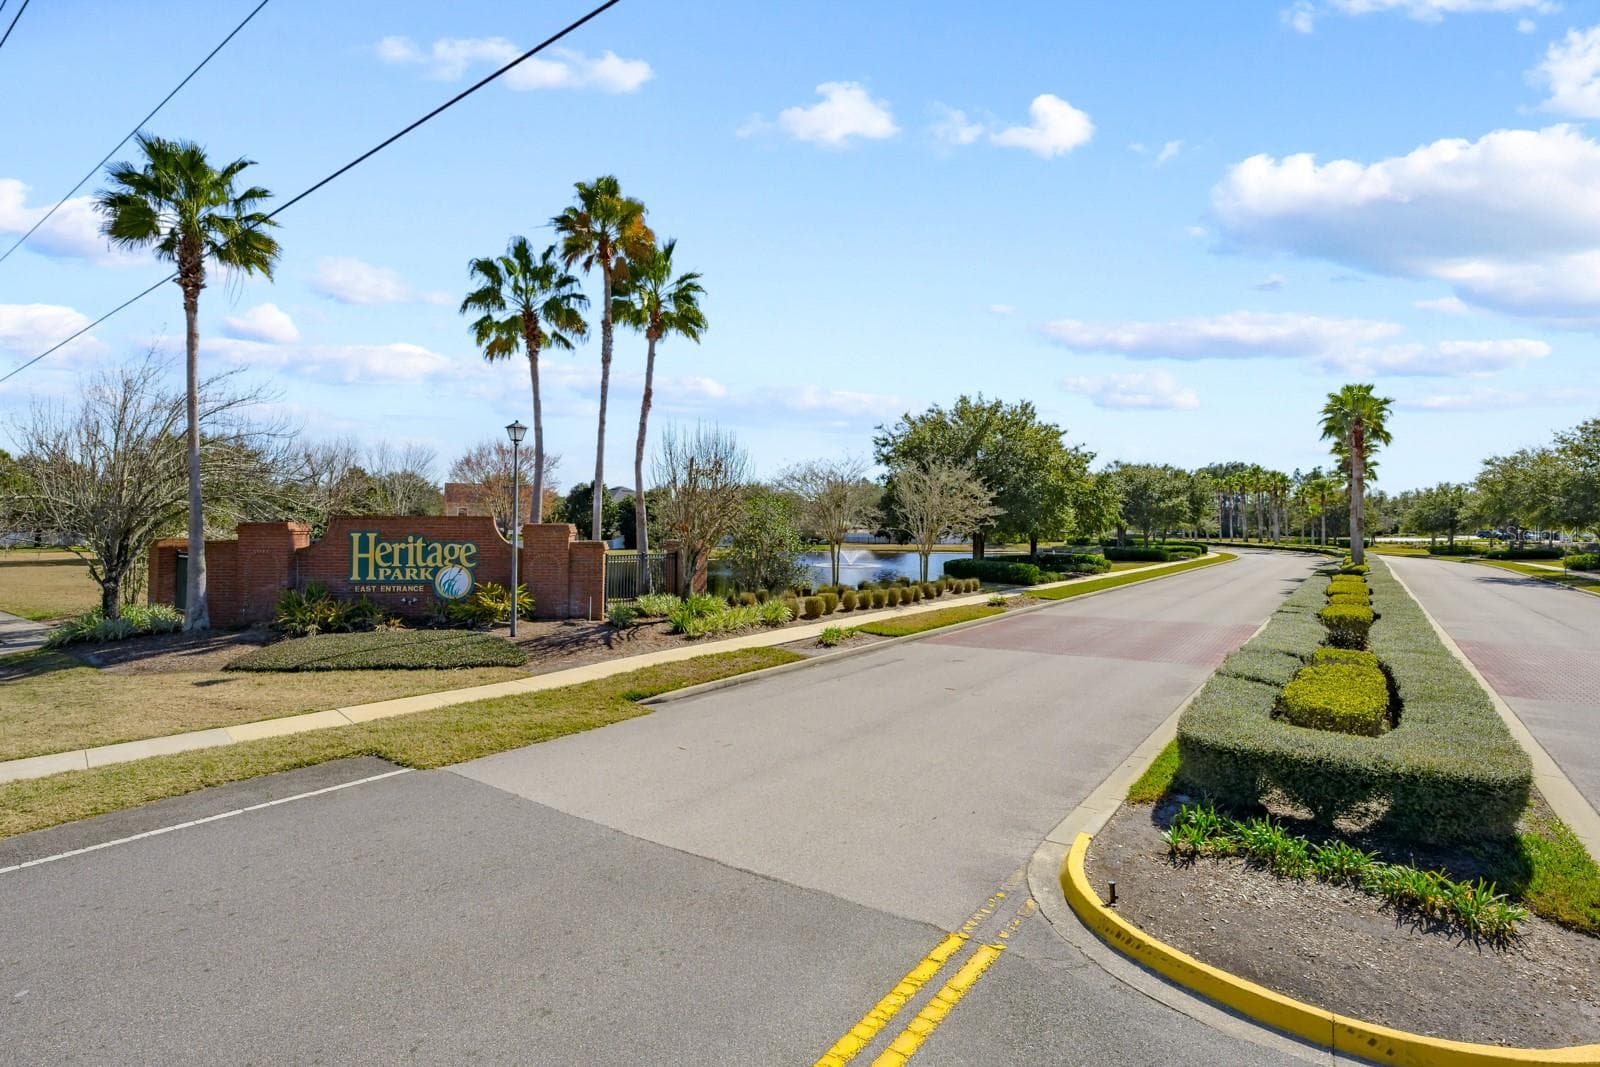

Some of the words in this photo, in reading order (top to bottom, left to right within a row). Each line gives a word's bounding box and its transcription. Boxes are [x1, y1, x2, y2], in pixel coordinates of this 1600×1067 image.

[350, 532, 477, 580] Heritage
[378, 567, 434, 580] PARK
[354, 585, 376, 593] EAST
[380, 585, 424, 593] ENTRANCE
